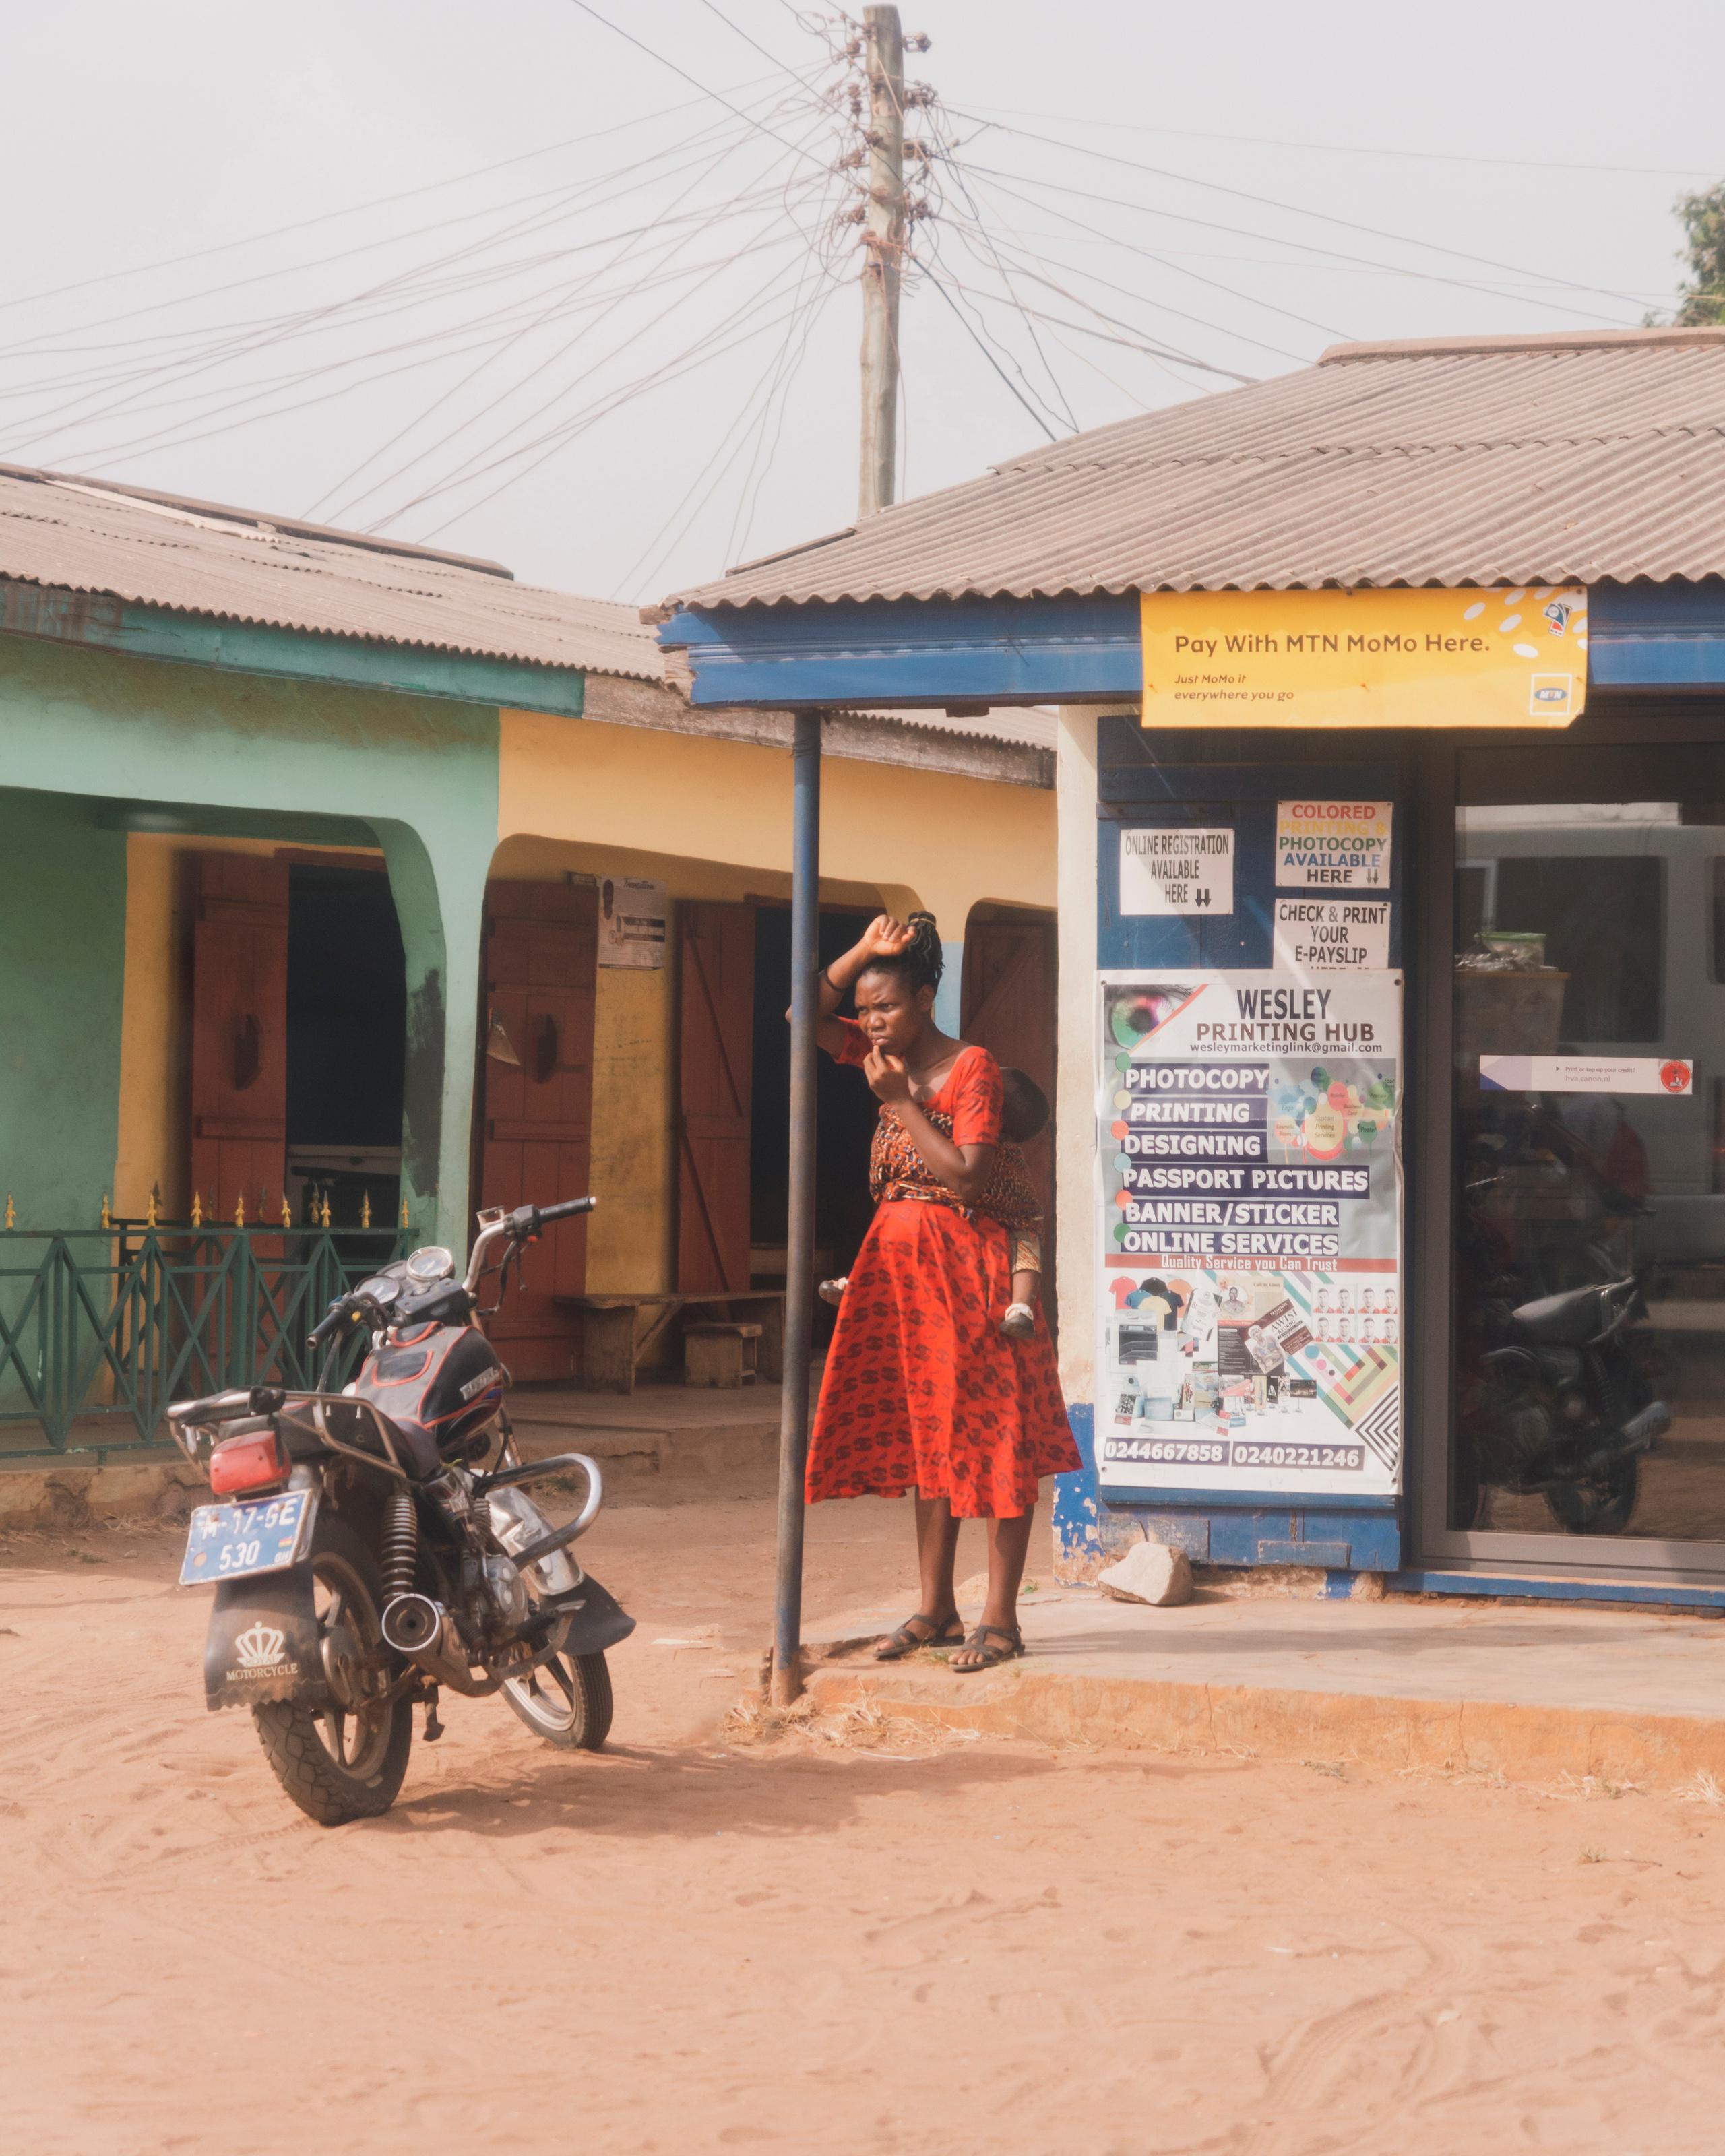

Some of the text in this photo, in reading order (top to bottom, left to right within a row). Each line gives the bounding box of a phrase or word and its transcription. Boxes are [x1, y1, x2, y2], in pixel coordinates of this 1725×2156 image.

[1174, 633, 1491, 658] Pay With MTN MoMo Here.
[1174, 674, 1246, 685] Just MoMo it
[1174, 689, 1294, 703] everywhere you go
[1539, 690, 1562, 699] MTN
[1292, 804, 1376, 819] COLORED
[1280, 820, 1387, 835] PRINTING &
[1125, 834, 1229, 855] ONLINE REGISTRATION
[1279, 836, 1388, 852] PHOTOCOPY
[1150, 859, 1200, 879] AVAILABLE
[1283, 852, 1381, 868] AVAILABLE
[1307, 868, 1352, 883] HERE
[1164, 883, 1189, 903] HERE
[1279, 904, 1387, 924] CHECK & PRINT
[1310, 925, 1348, 943] YOUR
[1295, 945, 1367, 964] E-PAYSLIP
[1237, 988, 1332, 1020] WESLEY
[1197, 1023, 1375, 1042] PRINTING HUB
[1190, 1042, 1383, 1054] wesleymarketinglink@gmail.com
[1125, 1068, 1269, 1089] PHOTOCOPY
[1130, 1102, 1250, 1123] PRINTING
[1124, 1135, 1261, 1156] DESIGNING
[1122, 1168, 1369, 1191] PASSPORT PICTURES
[1125, 1202, 1338, 1226] BANNER/STICKER
[1123, 1230, 1338, 1255] ONLINE SERVICES
[1161, 1254, 1337, 1271] Quality Service you Can Trust
[1104, 1440, 1223, 1463] 0244667858
[1234, 1445, 1360, 1468] 0240221246
[218, 1539, 261, 1571] 530
[274, 1550, 291, 1563] GH
[245, 1655, 278, 1667] ROYAL
[226, 1663, 299, 1681] MOTORCYCLE
